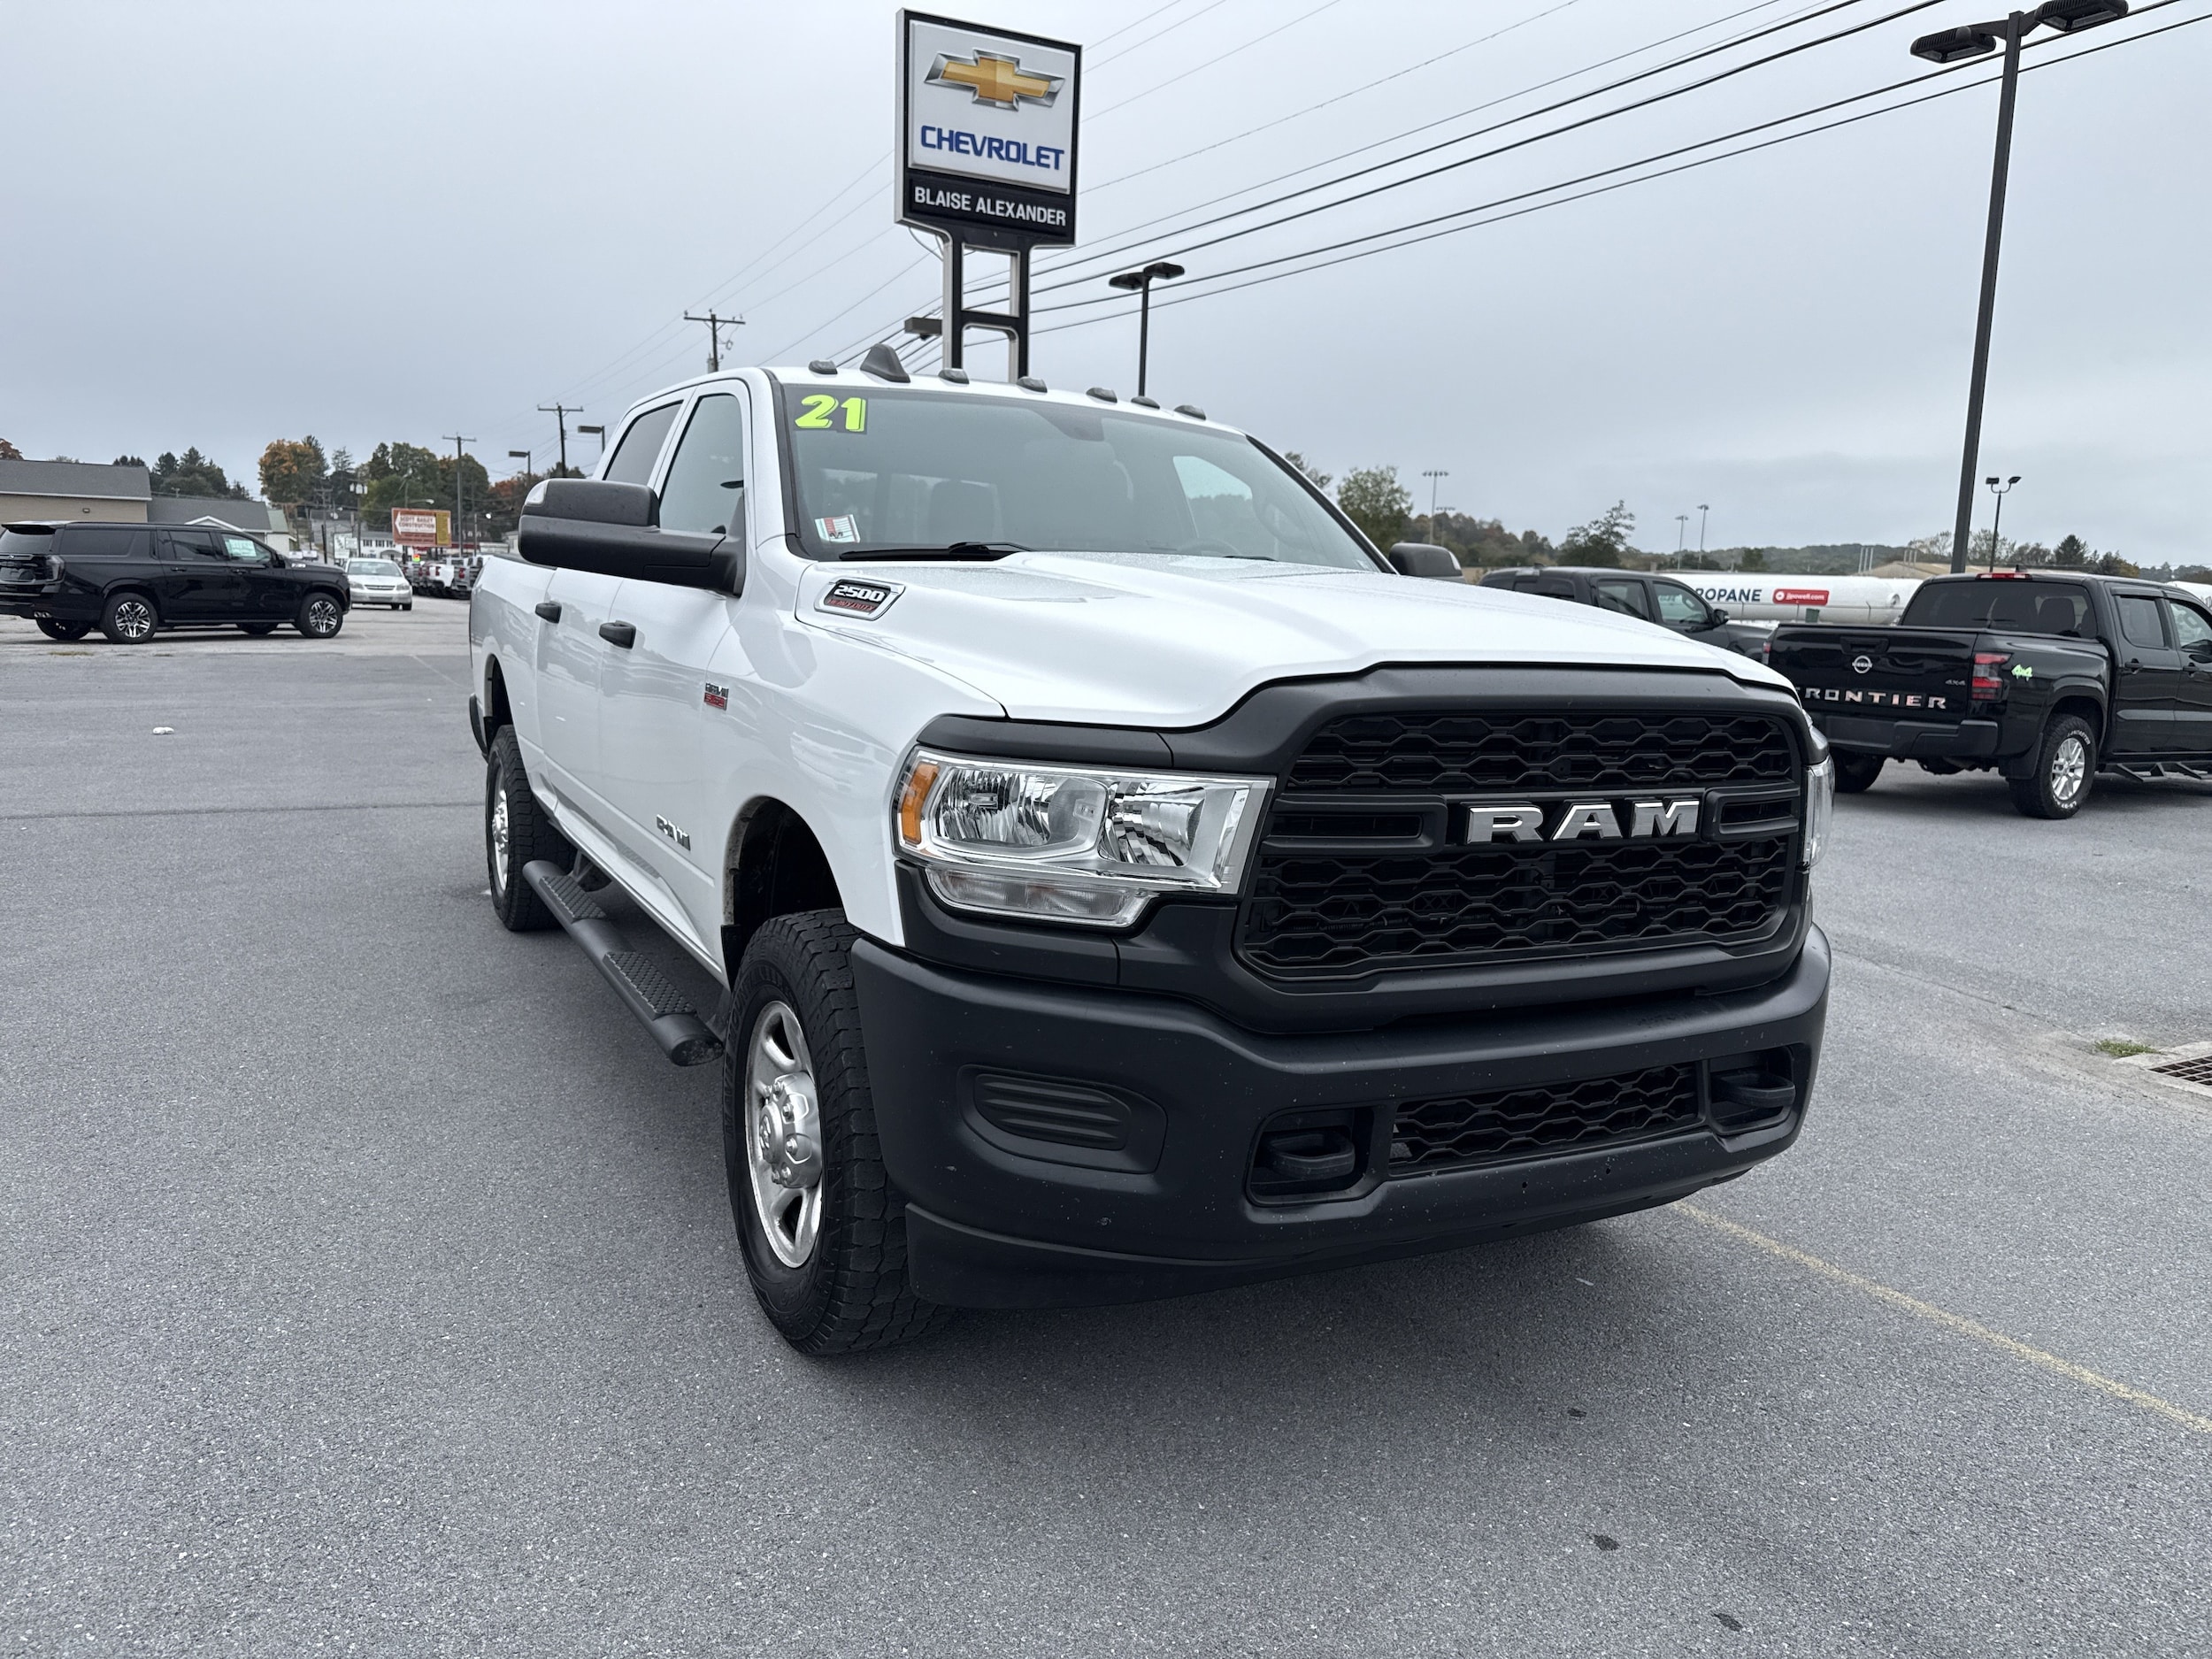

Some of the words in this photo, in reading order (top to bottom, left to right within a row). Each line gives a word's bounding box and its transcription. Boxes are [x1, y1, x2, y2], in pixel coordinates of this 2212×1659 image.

[921, 125, 1064, 170] CHEVROLET
[915, 187, 972, 211] BLAISE
[976, 197, 1066, 227] ALEXANDER
[795, 395, 866, 432] 21
[833, 585, 885, 602] 2500
[1795, 687, 1946, 709] RONTIER
[657, 814, 691, 851] RAM
[1465, 800, 1701, 844] RAM
